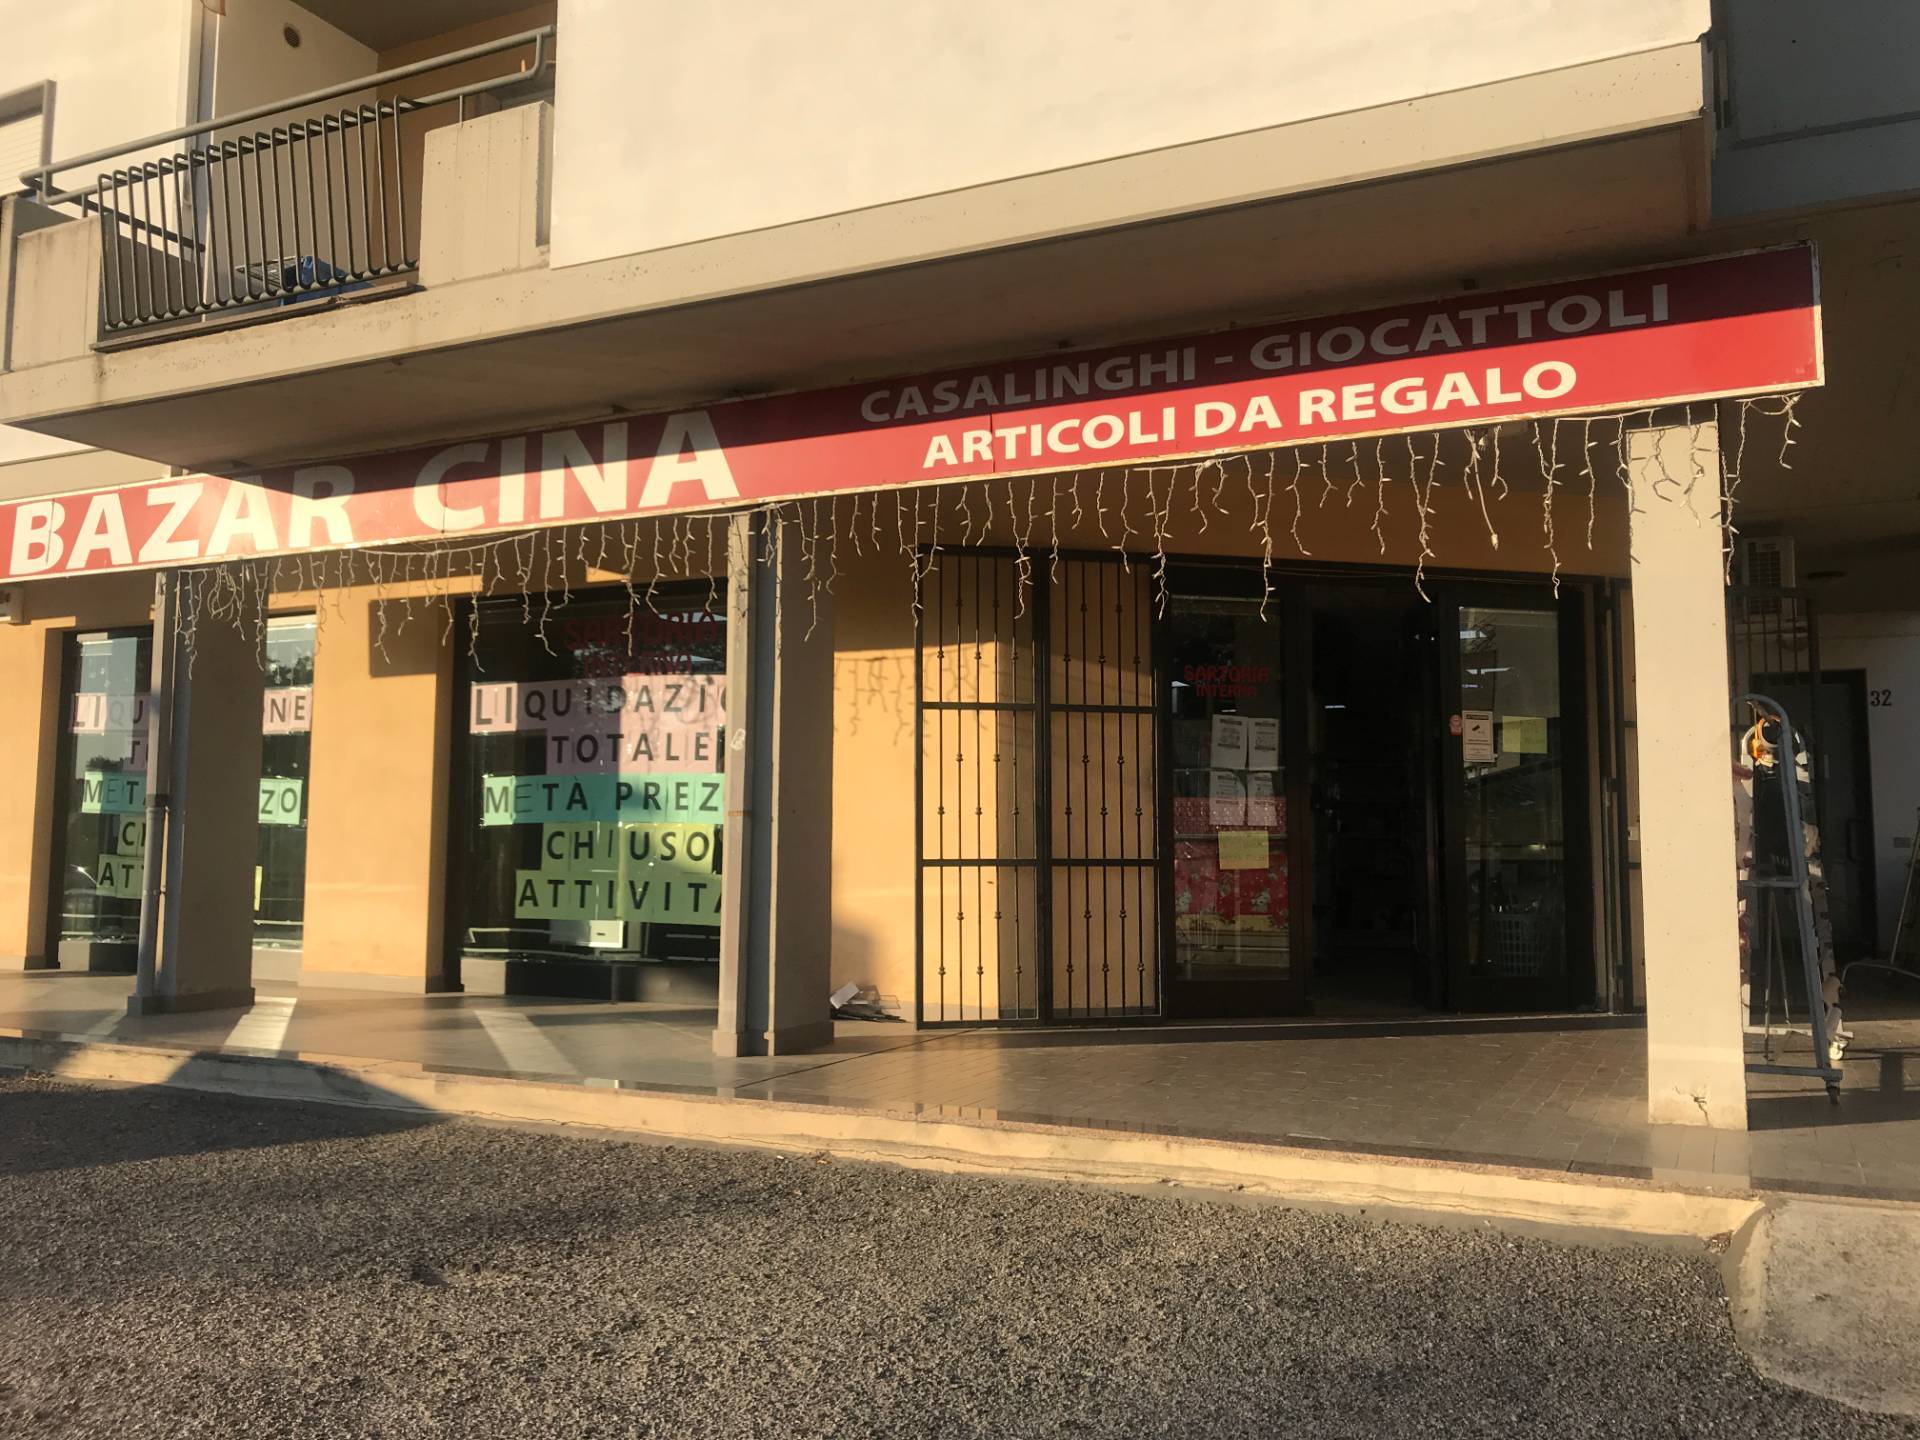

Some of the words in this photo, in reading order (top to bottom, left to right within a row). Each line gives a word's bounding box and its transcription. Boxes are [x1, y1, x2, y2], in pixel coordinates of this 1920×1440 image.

[860, 346, 1196, 425] CASALINGHI
[1250, 284, 1670, 372] GIOCATTOLI
[922, 406, 1177, 470] ARTICOLI
[1194, 395, 1282, 439] DA
[1298, 359, 1578, 426] REGALO
[9, 464, 356, 576] BAZAR
[411, 411, 741, 532] CINA
[475, 684, 728, 725] LIQUIDAZI
[1870, 689, 1892, 707] 32
[552, 733, 710, 764] TOTALE
[83, 779, 146, 805] MET
[546, 830, 710, 862] CHIUSO
[99, 862, 145, 889] AT
